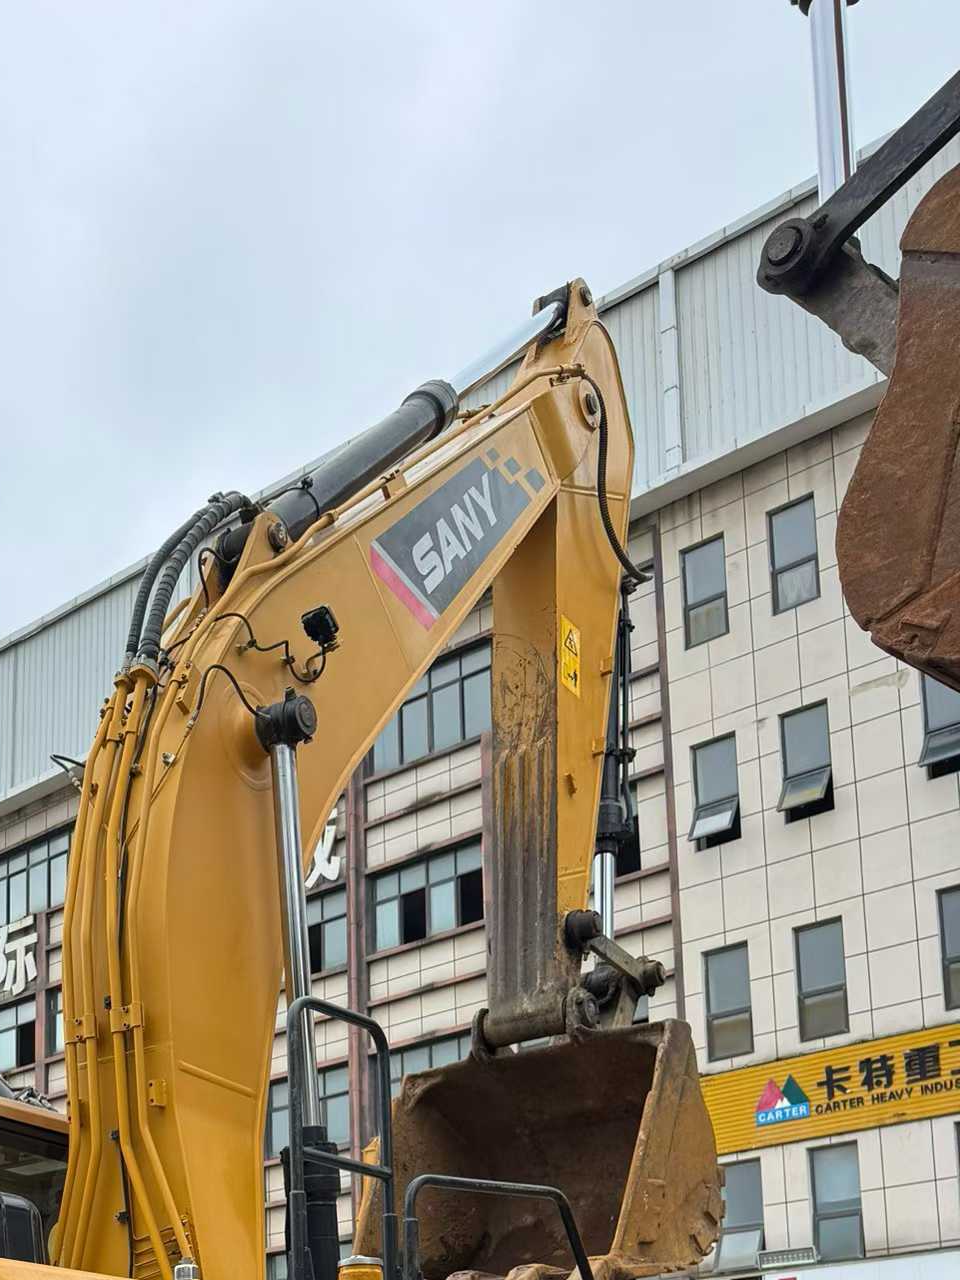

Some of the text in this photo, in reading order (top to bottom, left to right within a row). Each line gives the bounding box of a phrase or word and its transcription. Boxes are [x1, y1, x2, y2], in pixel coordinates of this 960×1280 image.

[412, 471, 497, 594] SANY
[757, 1105, 809, 1122] CARTER
[815, 1096, 865, 1115] CARTER
[871, 1087, 913, 1107] HEAVY
